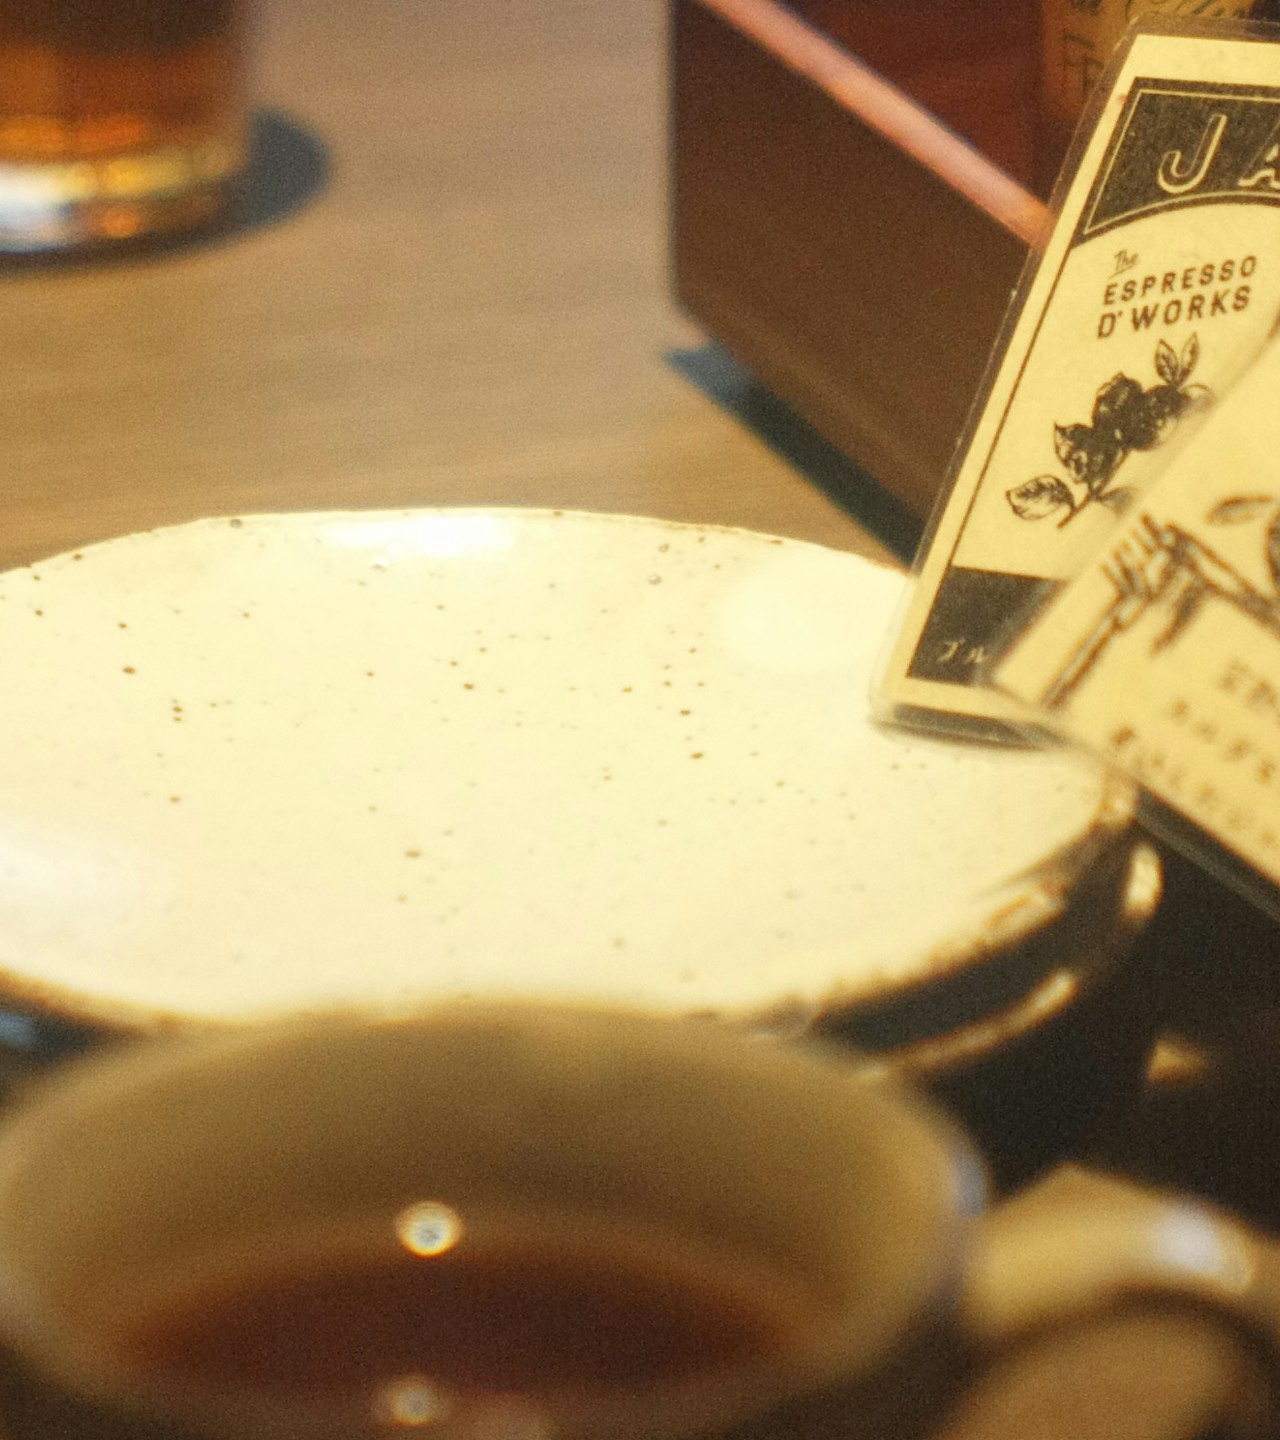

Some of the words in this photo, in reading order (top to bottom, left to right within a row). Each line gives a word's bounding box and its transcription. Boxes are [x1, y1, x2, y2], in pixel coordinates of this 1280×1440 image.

[1110, 248, 1139, 275] The
[1102, 255, 1258, 307] ESPRESSO
[936, 636, 990, 665] ブル
